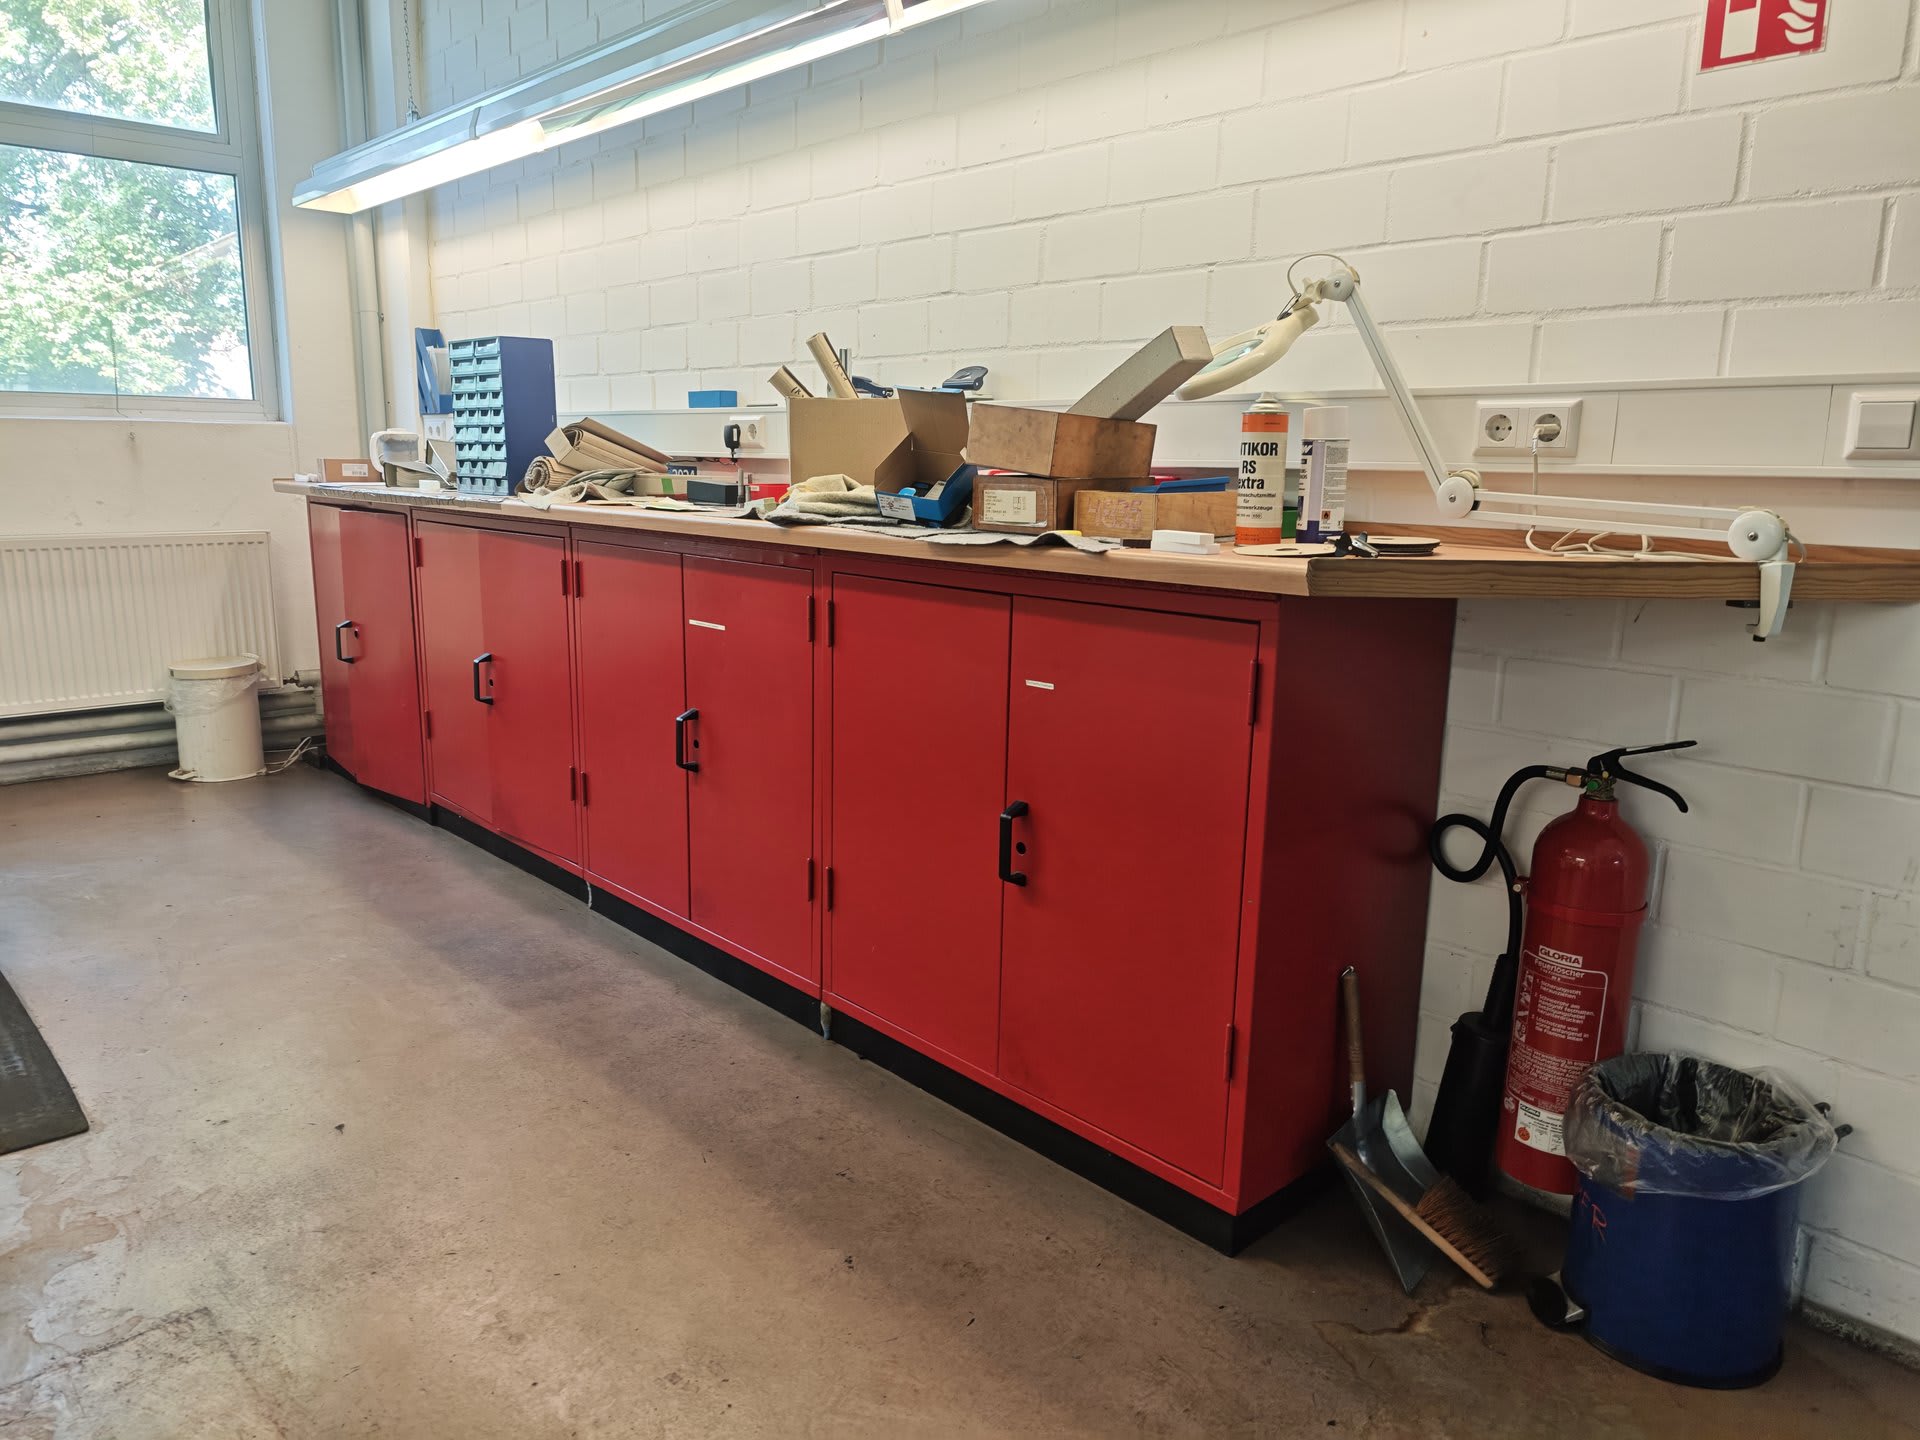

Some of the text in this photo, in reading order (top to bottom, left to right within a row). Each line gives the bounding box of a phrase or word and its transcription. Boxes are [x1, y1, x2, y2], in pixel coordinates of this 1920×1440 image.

[1240, 442, 1279, 457] TIKOR
[1242, 460, 1257, 474] RS
[1539, 947, 1581, 966] GLORIA
